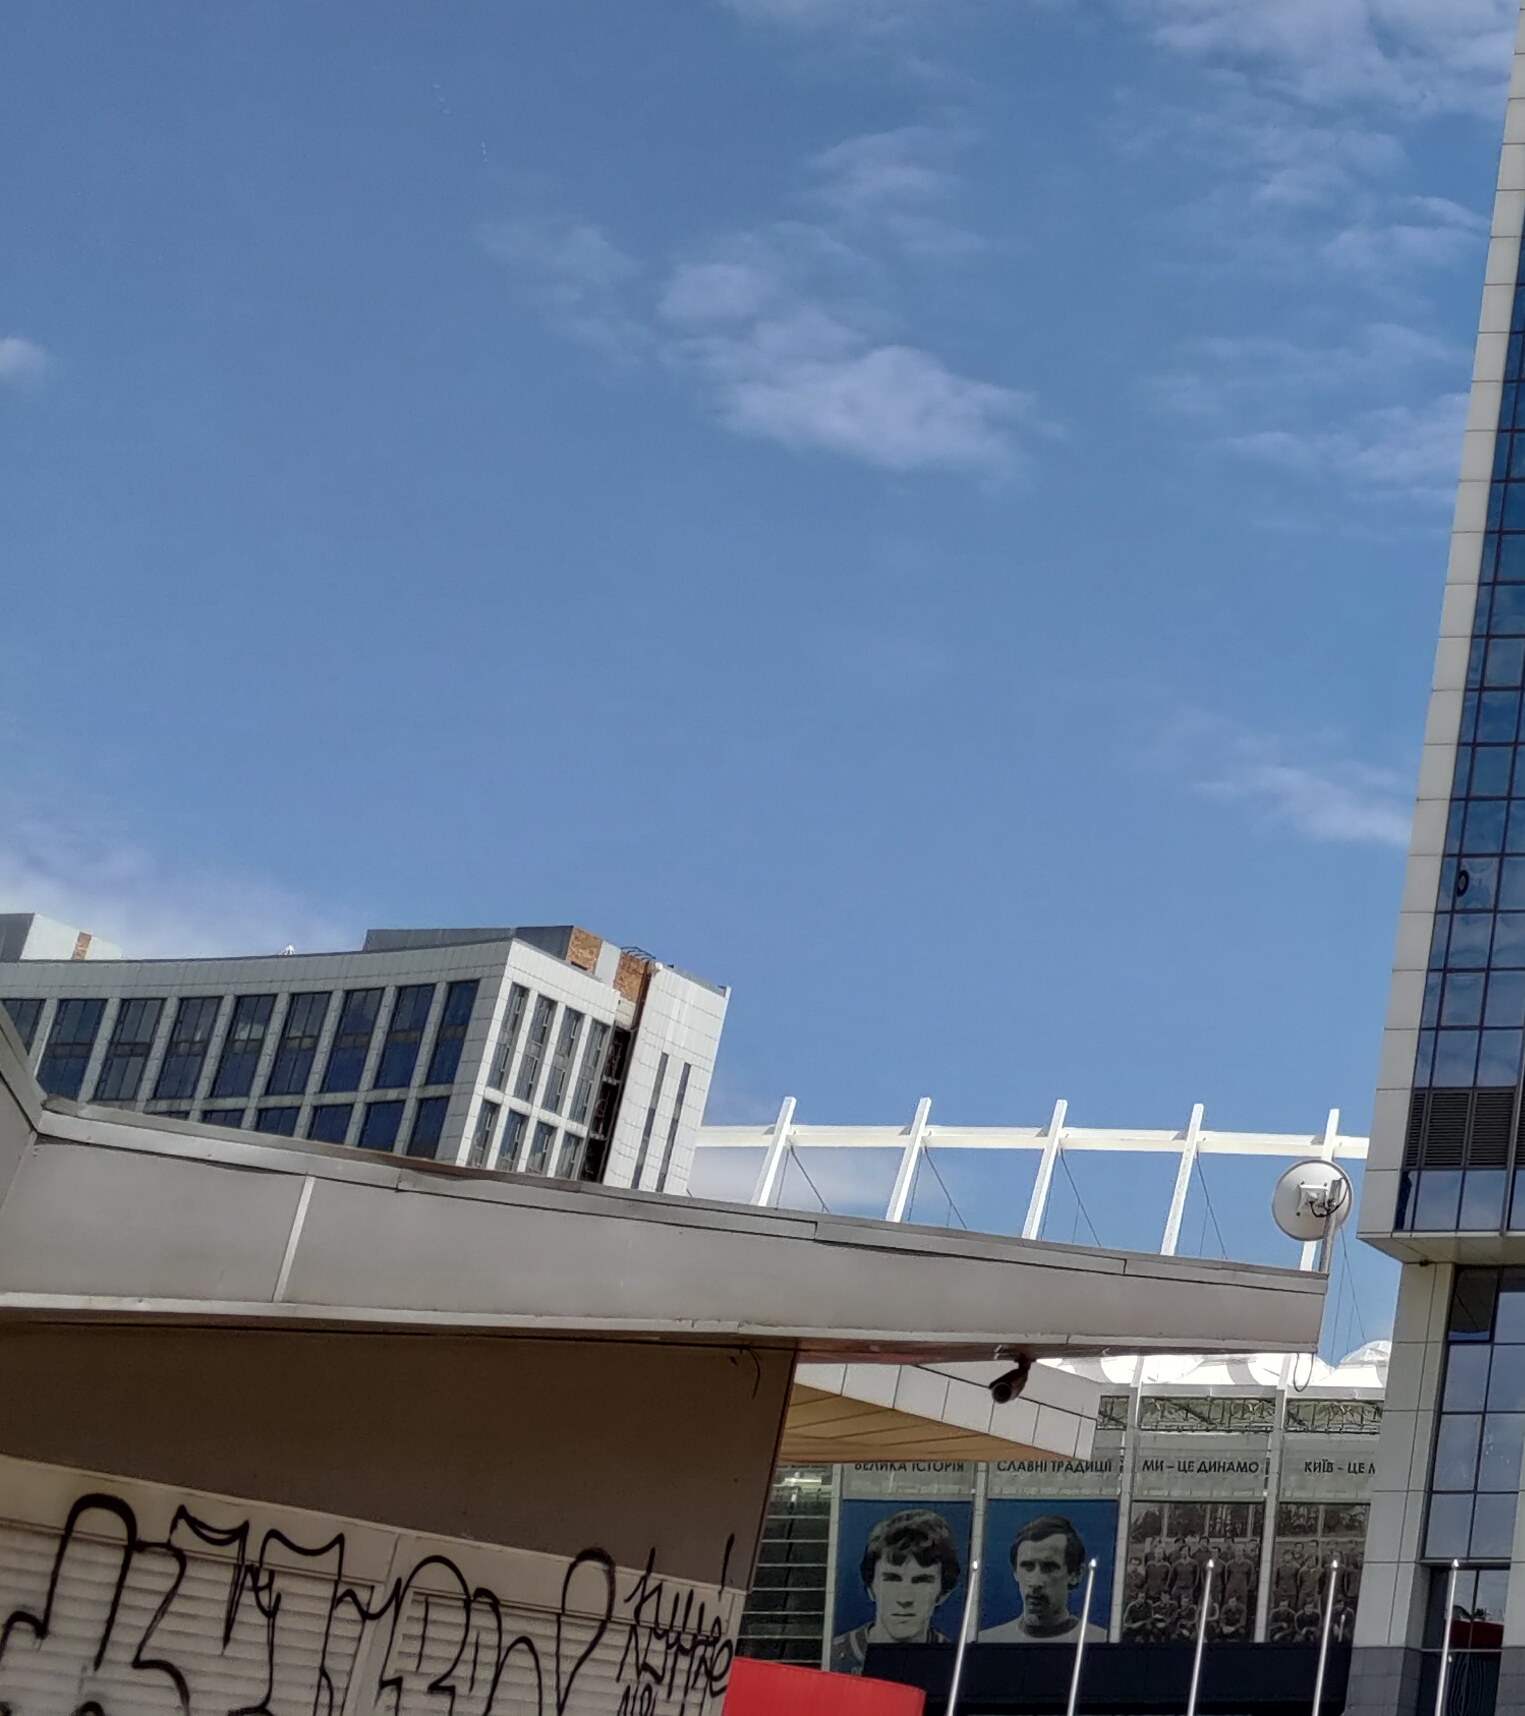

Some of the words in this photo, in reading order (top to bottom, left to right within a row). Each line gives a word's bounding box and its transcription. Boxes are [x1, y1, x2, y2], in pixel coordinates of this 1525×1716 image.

[997, 1460, 1047, 1473] СЛАВНІ
[1142, 1460, 1164, 1473] МИ
[1177, 1461, 1195, 1474] ЦЕ
[1196, 1461, 1260, 1474] ДИНАМО
[1304, 1458, 1334, 1473] КИЇВ
[1347, 1461, 1365, 1475] ЦЕ
